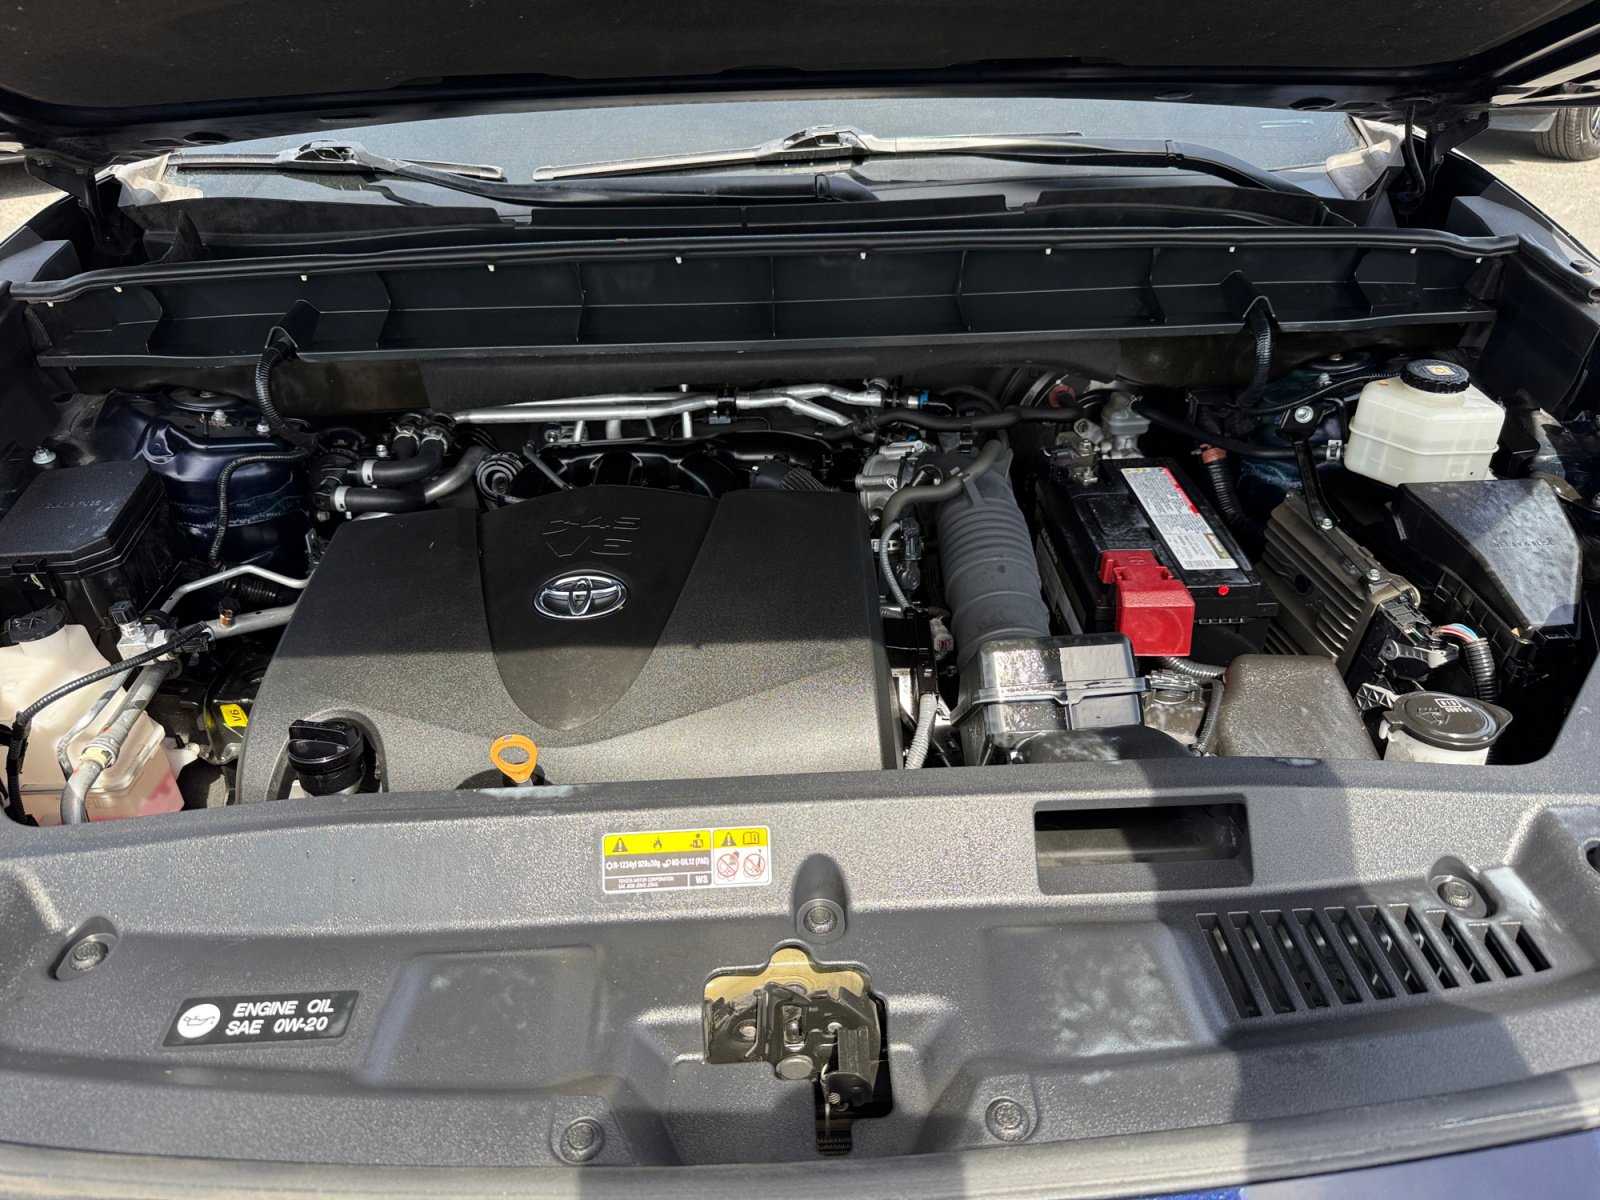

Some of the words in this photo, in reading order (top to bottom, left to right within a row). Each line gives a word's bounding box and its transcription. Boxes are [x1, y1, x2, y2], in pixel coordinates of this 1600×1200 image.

[695, 856, 710, 866] (PAG)
[695, 875, 709, 884] WS
[232, 1000, 299, 1018] ENGINE
[307, 998, 334, 1013] OIL
[225, 1019, 264, 1036] SAE
[273, 1016, 328, 1034] 0W-20
